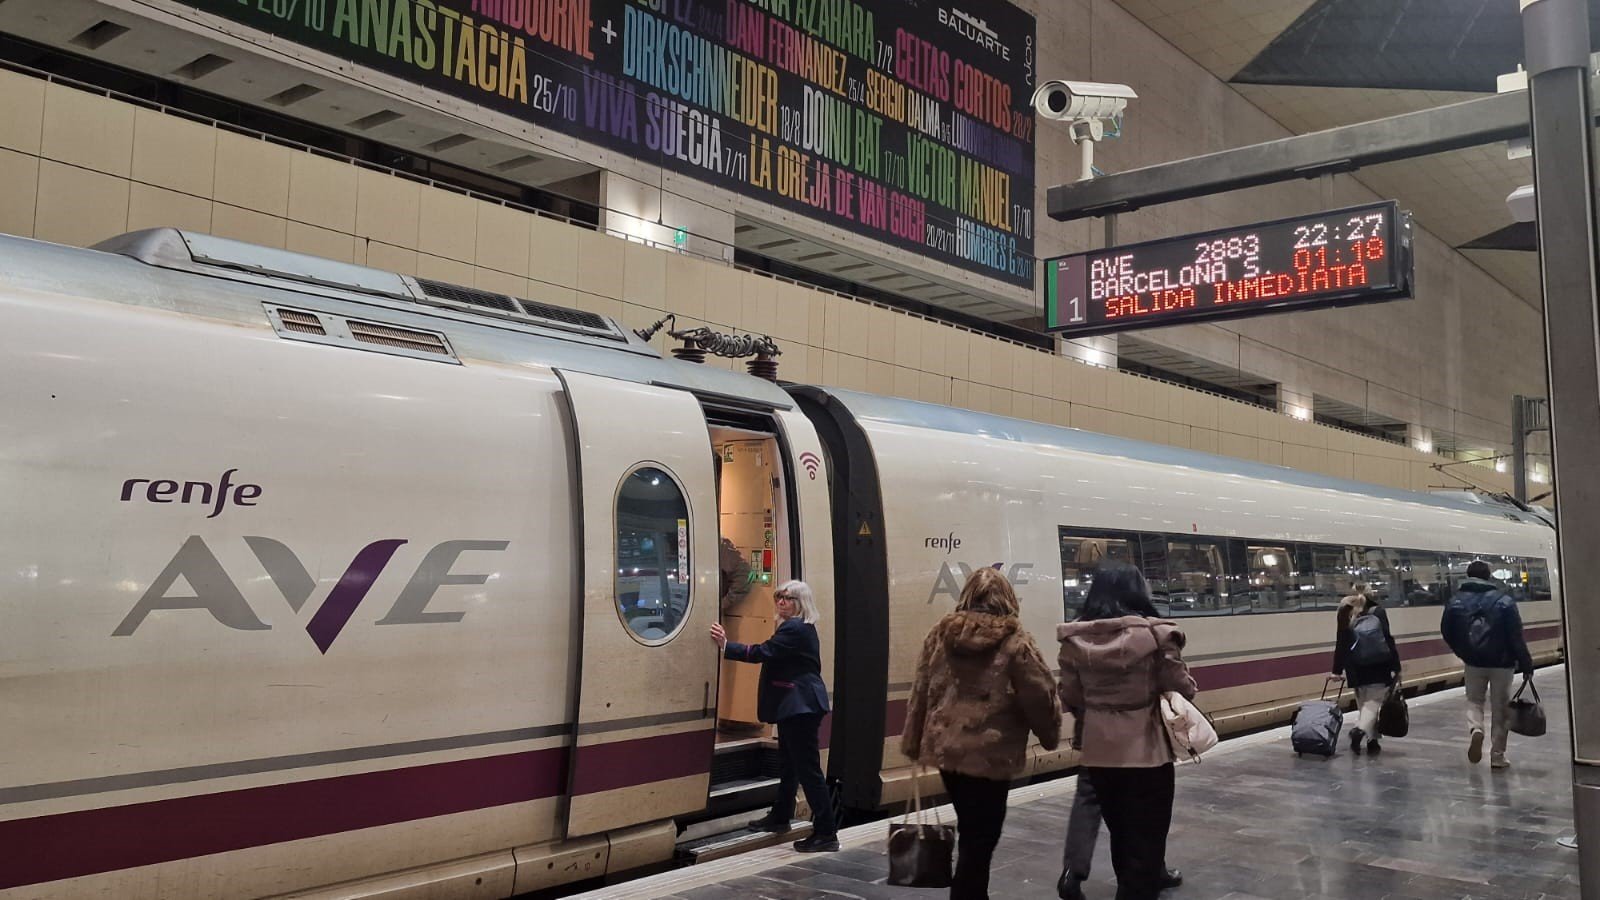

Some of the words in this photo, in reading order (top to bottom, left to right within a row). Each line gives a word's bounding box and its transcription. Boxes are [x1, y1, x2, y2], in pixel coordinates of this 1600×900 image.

[332, 0, 528, 104] ANASTACIA
[533, 74, 577, 121] 25/10
[726, 0, 765, 60] DANI
[848, 77, 865, 105] 25/4
[876, 40, 893, 74] 7/2
[938, 7, 1011, 62] BALUARTE
[866, 67, 905, 123] SERGIO
[907, 88, 941, 141] DALMA
[895, 26, 950, 102] CELTAS
[953, 58, 1012, 134] CORTOS
[583, 65, 639, 145] VIVA
[645, 91, 723, 174] SUECIA
[725, 147, 748, 182] 7/11
[781, 105, 801, 146] 18/8
[802, 84, 852, 167] DOINU
[855, 108, 883, 180] BAT
[884, 150, 905, 190] 17/10
[750, 132, 773, 191] LA
[777, 144, 832, 212] OREJA
[835, 167, 855, 221] DE
[857, 176, 888, 232] VAN
[889, 189, 926, 245] GOGH
[959, 154, 1012, 234] MANUEL
[1013, 203, 1032, 240] 17/10
[955, 216, 1007, 272] HOMBRES
[1009, 236, 1017, 274] G
[1091, 254, 1134, 280] AVE
[1195, 233, 1259, 264] 2883
[1293, 212, 1384, 249] 22:27
[1091, 263, 1227, 300] BARCELONA
[1293, 236, 1384, 270] 01:18
[1069, 296, 1084, 322] 1
[1105, 287, 1196, 318] SALIDA
[1213, 264, 1367, 304] INMEDIATA
[119, 468, 263, 519] renfe
[924, 531, 961, 555] renfe
[110, 534, 511, 656] AVE
[926, 560, 1034, 605] AE
